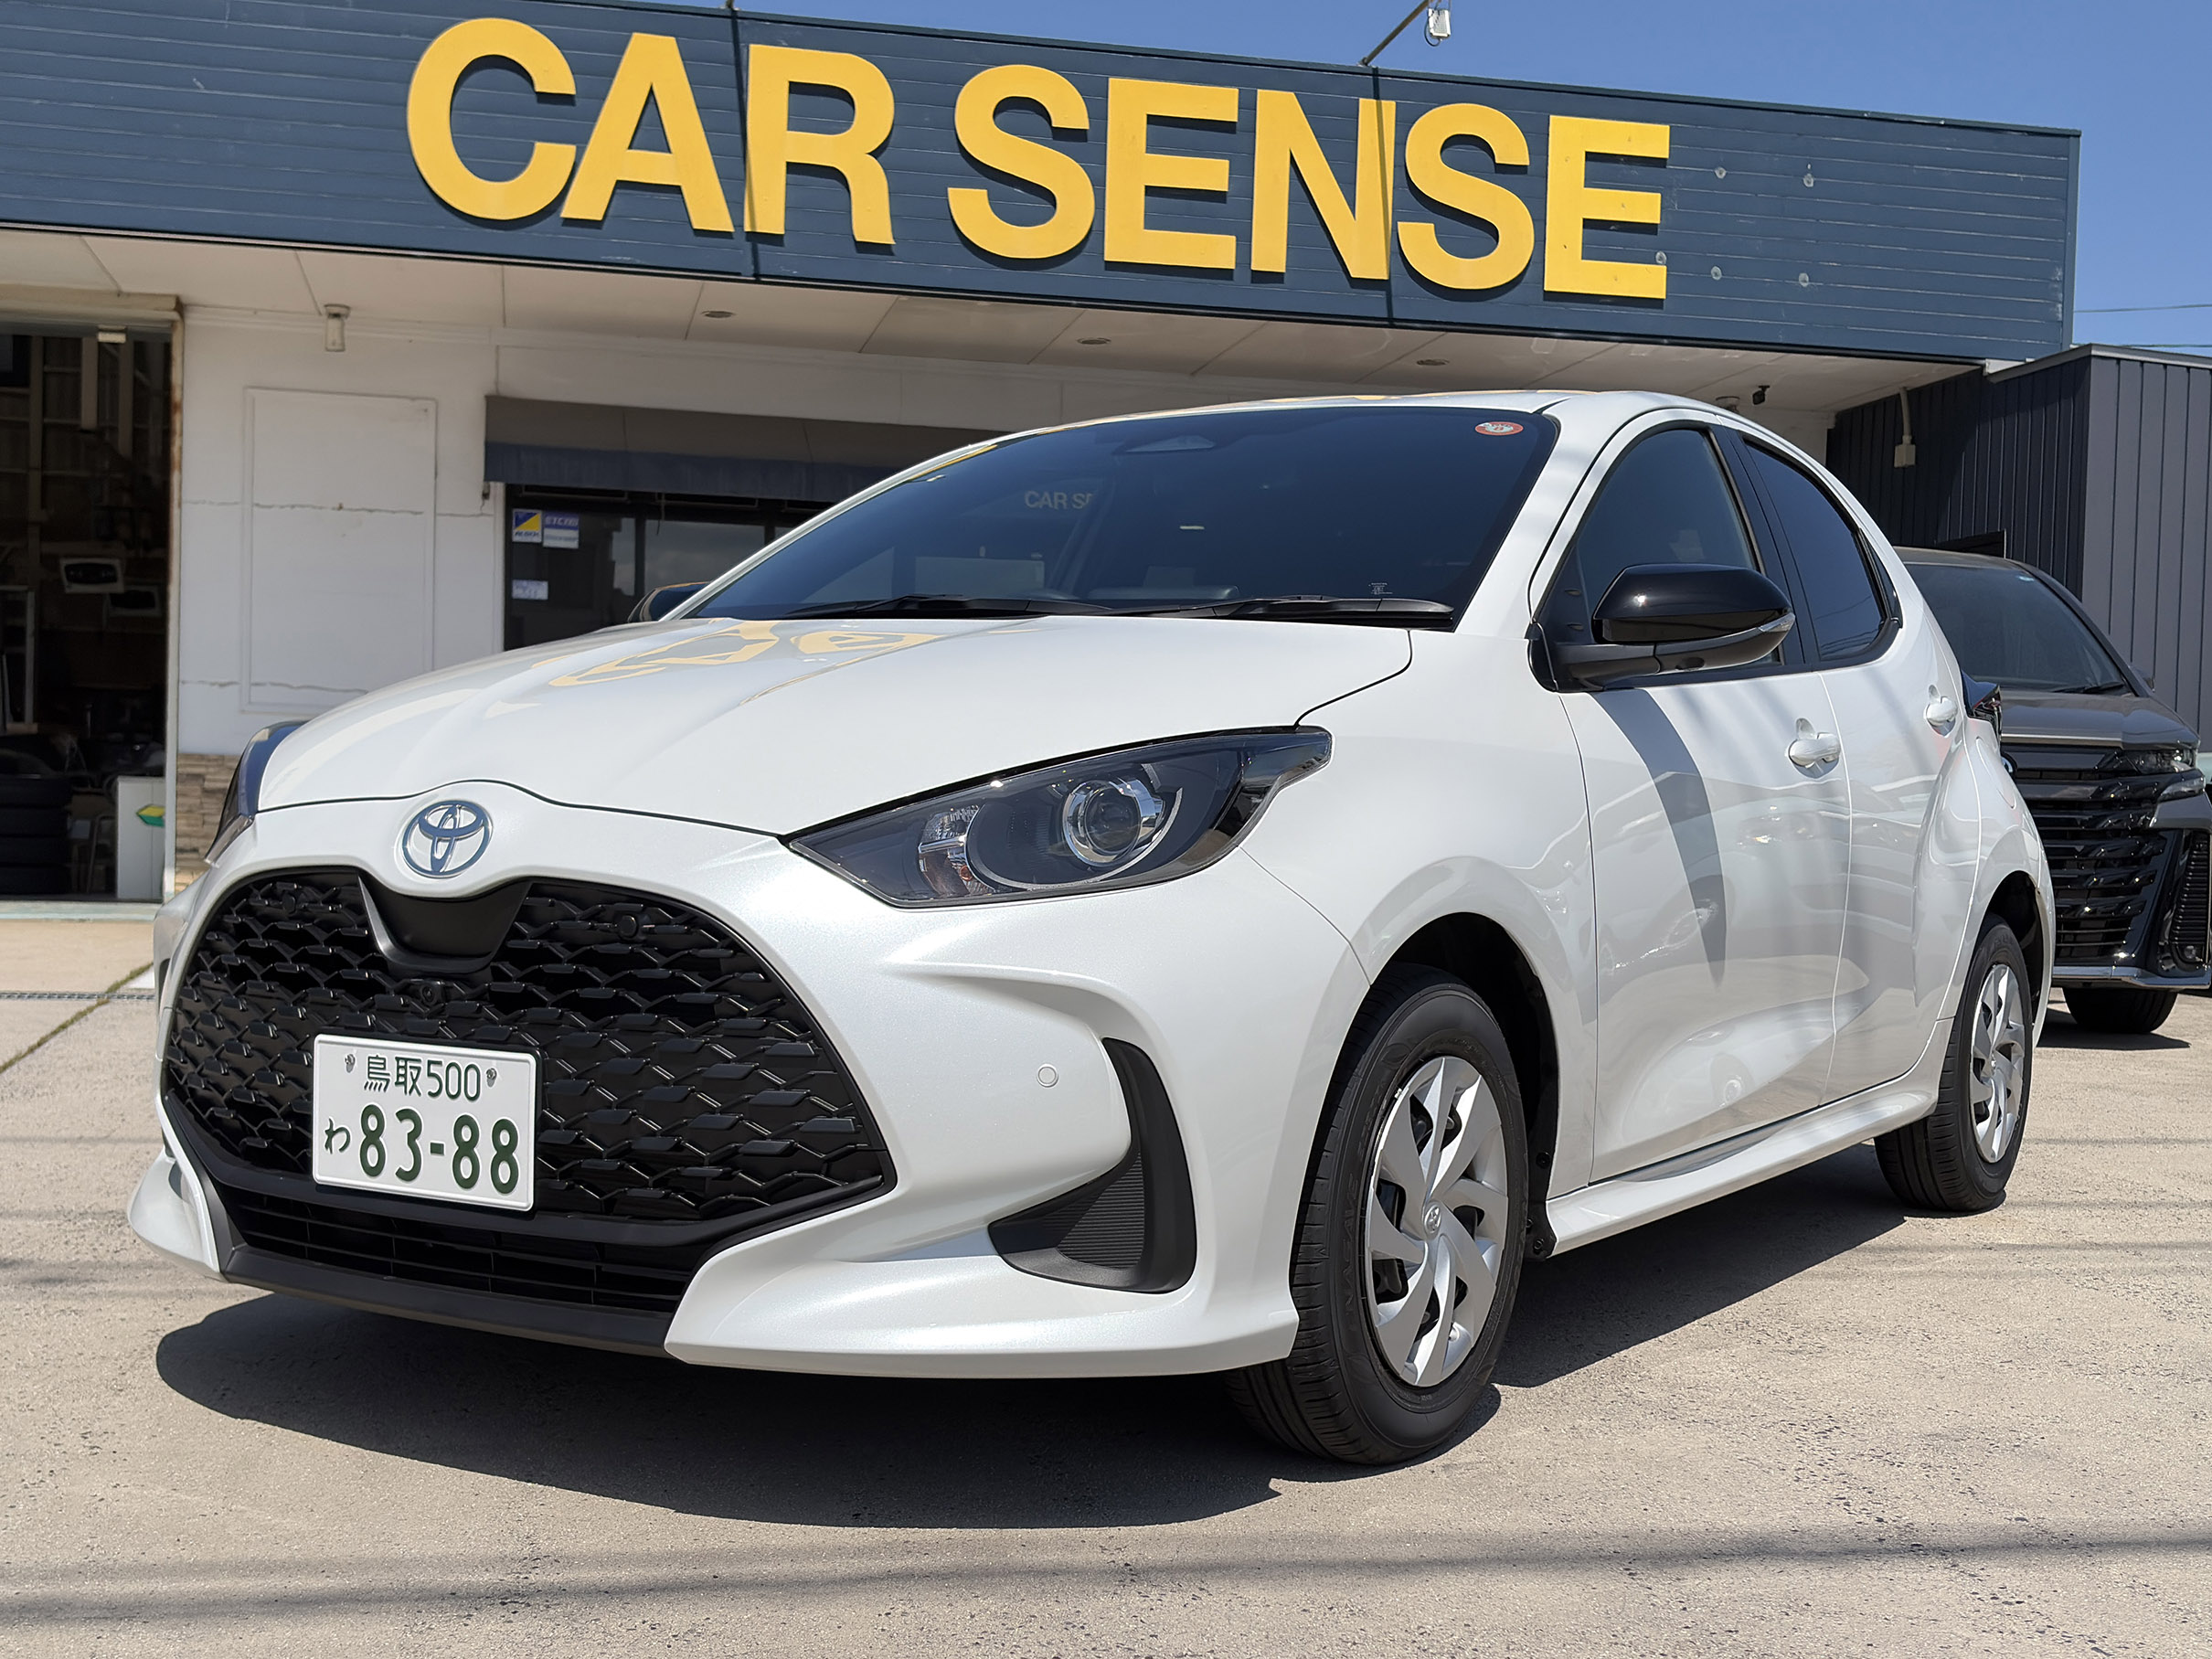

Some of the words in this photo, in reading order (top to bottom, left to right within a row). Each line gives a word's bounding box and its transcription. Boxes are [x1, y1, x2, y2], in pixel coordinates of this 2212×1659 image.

[408, 17, 896, 245] CAR
[947, 64, 1670, 300] SENSE
[1025, 491, 1068, 510] CAR
[324, 1118, 351, 1154] わ
[359, 1104, 519, 1194] 83-88
